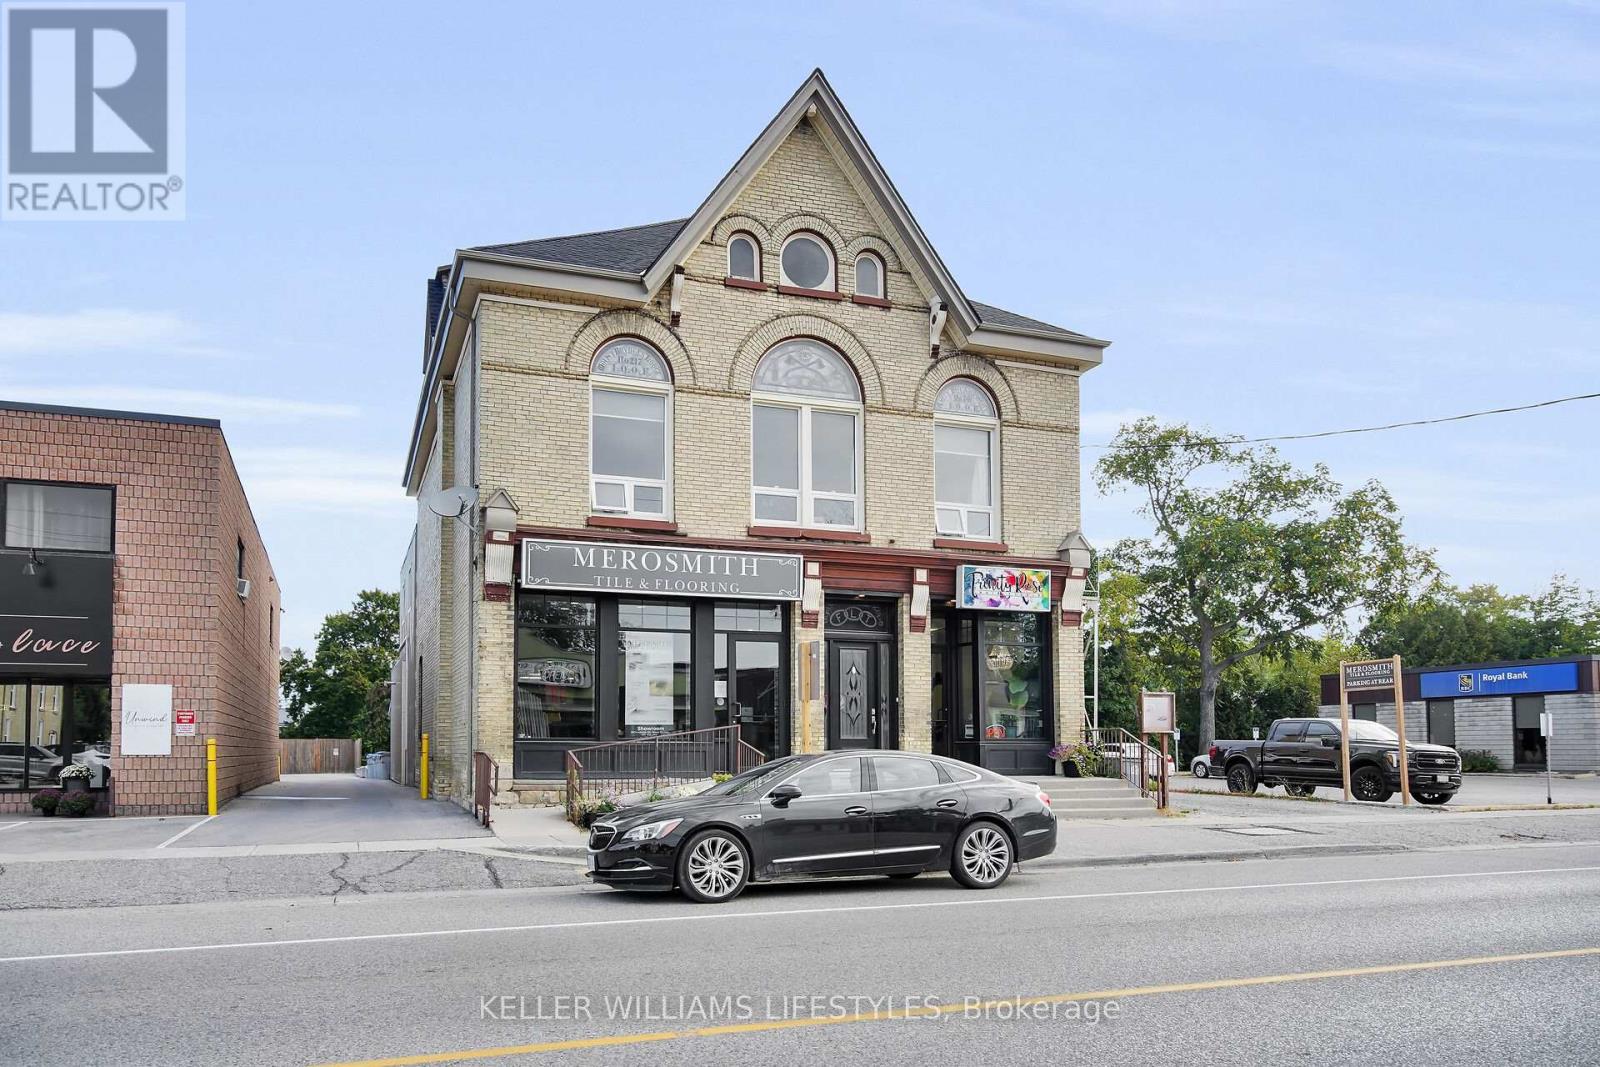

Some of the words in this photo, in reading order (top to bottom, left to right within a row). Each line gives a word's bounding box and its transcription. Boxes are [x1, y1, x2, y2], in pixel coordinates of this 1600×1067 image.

[572, 547, 761, 577] MEROSMITH
[593, 575, 633, 589] TILE
[639, 578, 650, 590] &
[655, 578, 741, 594] FLOORING
[12, 628, 100, 654] lace
[1346, 662, 1394, 674] MEROSMITH
[1346, 679, 1370, 687] PARKING
[1379, 677, 1394, 685] REAR
[1482, 672, 1505, 683] Royal
[1507, 671, 1528, 680] Bank
